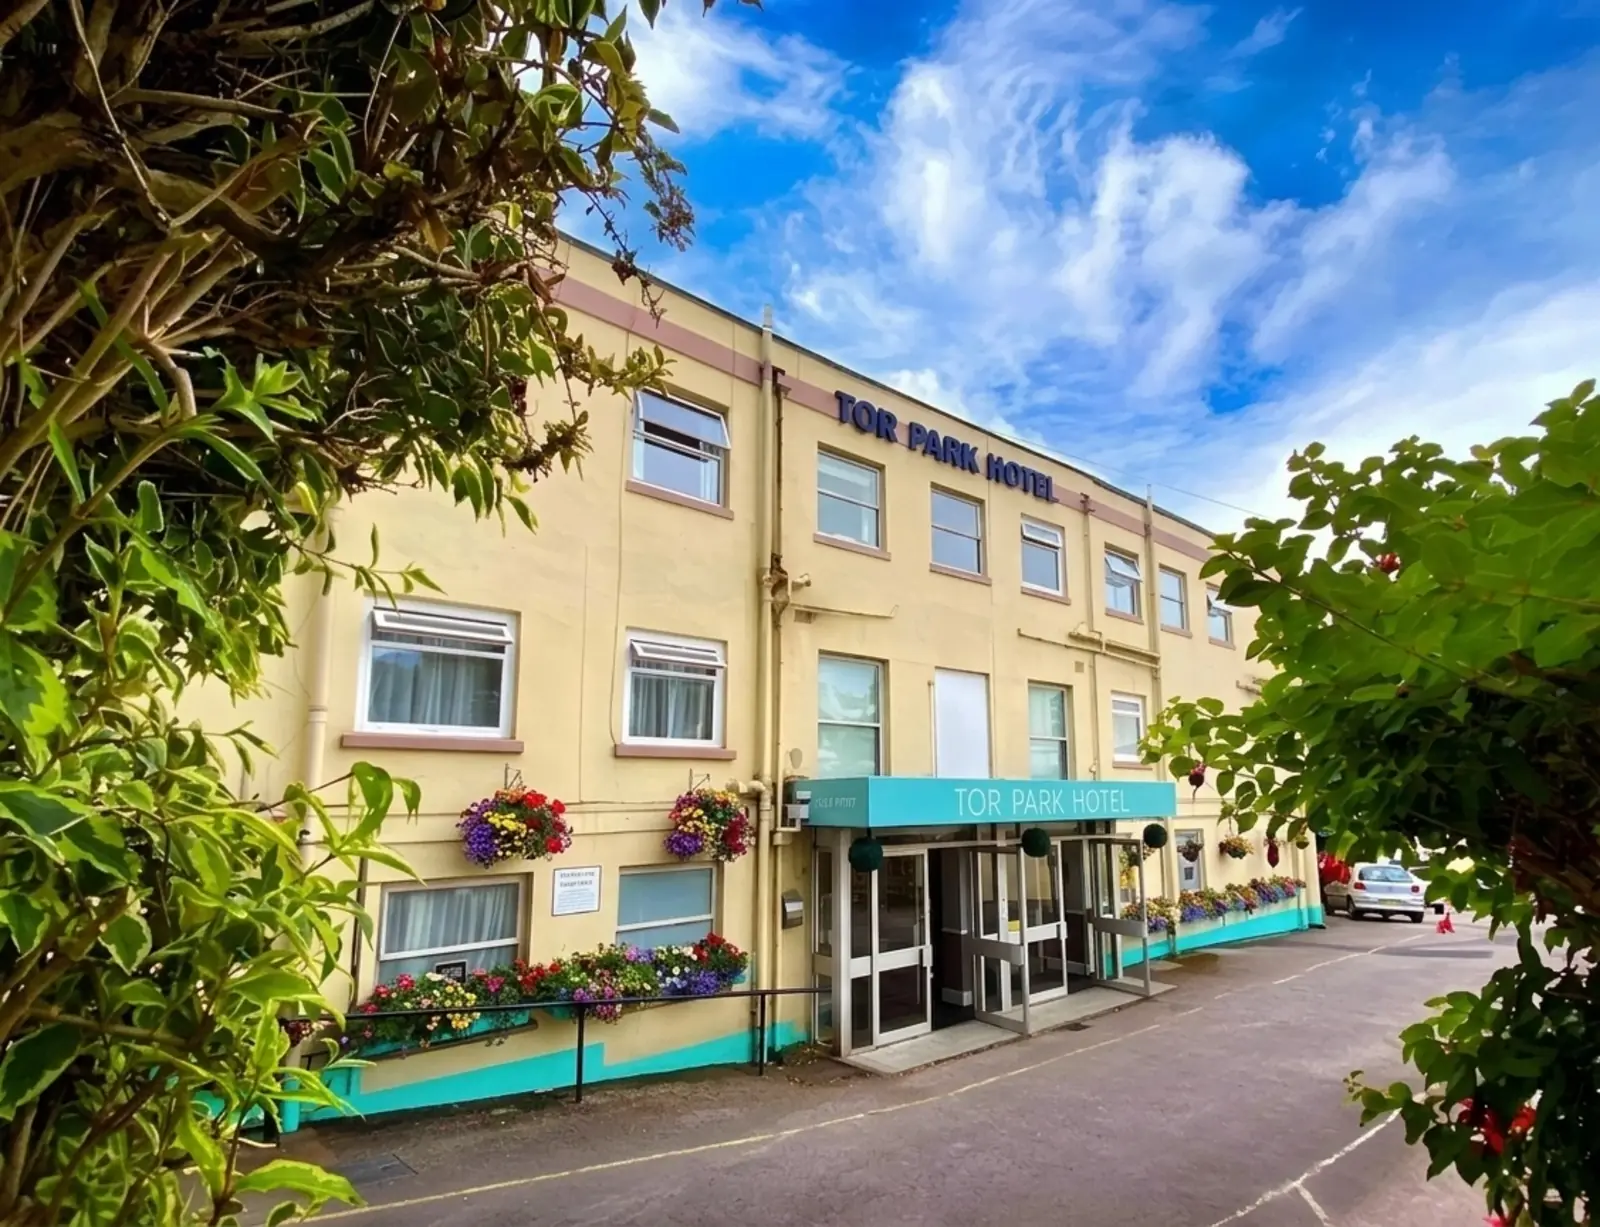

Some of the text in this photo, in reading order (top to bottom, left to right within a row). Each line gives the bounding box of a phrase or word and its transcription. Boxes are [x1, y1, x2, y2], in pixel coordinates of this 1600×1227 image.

[835, 390, 1059, 503] TOR PARK HOTEL
[954, 788, 1130, 816] TOR PARK HOTEL
